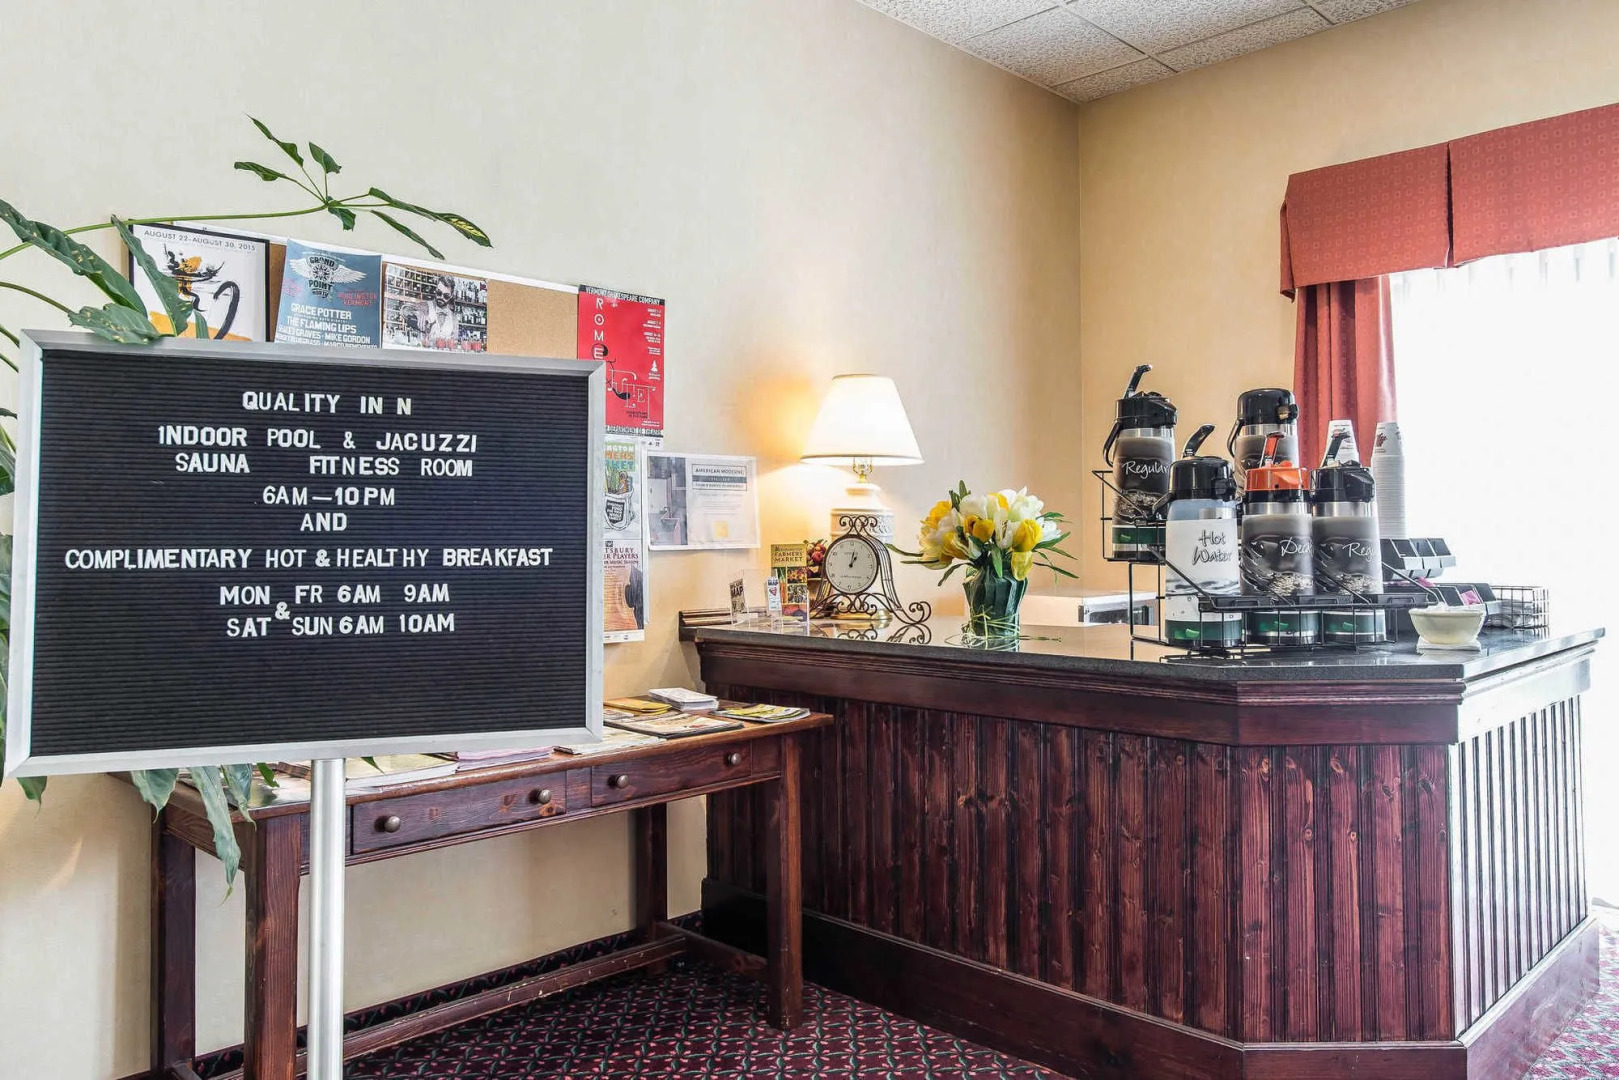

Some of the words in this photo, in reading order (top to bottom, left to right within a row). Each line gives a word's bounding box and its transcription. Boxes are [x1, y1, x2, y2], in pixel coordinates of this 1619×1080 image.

[144, 229, 176, 240] AUGUST
[238, 243, 256, 252] 2015
[308, 280, 333, 291] POINT
[638, 296, 661, 306] COMPANY
[290, 303, 317, 315] GRACE
[317, 308, 352, 320] POTTER
[287, 316, 300, 326] THE
[300, 318, 337, 332] FLAMING
[338, 323, 357, 334] LIPS
[325, 333, 341, 342] MIKE
[342, 335, 371, 344] GORDON
[242, 390, 341, 415] QUALITY
[267, 428, 321, 449] POOL
[343, 431, 356, 450] &
[376, 432, 478, 453] JACUZZI
[175, 453, 251, 475] SAUNA
[310, 456, 401, 477] FITNESS
[420, 458, 473, 477] ROOM
[1121, 460, 1169, 480] Regular
[300, 512, 348, 532] AND
[1197, 529, 1227, 548] Hot
[65, 548, 253, 571] COMPLIMENTARY
[265, 549, 308, 569] HOT
[315, 549, 331, 568] &
[337, 548, 430, 569] HEALTHY
[442, 548, 554, 569] BREAKFAST
[612, 552, 639, 560] PLAYERS
[1191, 548, 1233, 566] Water
[220, 585, 271, 606] MON
[295, 585, 323, 605] FR
[337, 584, 381, 604] 6AM
[404, 583, 450, 603] 9AM
[227, 616, 272, 637] SAT
[275, 602, 291, 621] &
[292, 616, 333, 636] SUN
[338, 615, 384, 634] 6AM
[400, 613, 455, 633] 10AM
